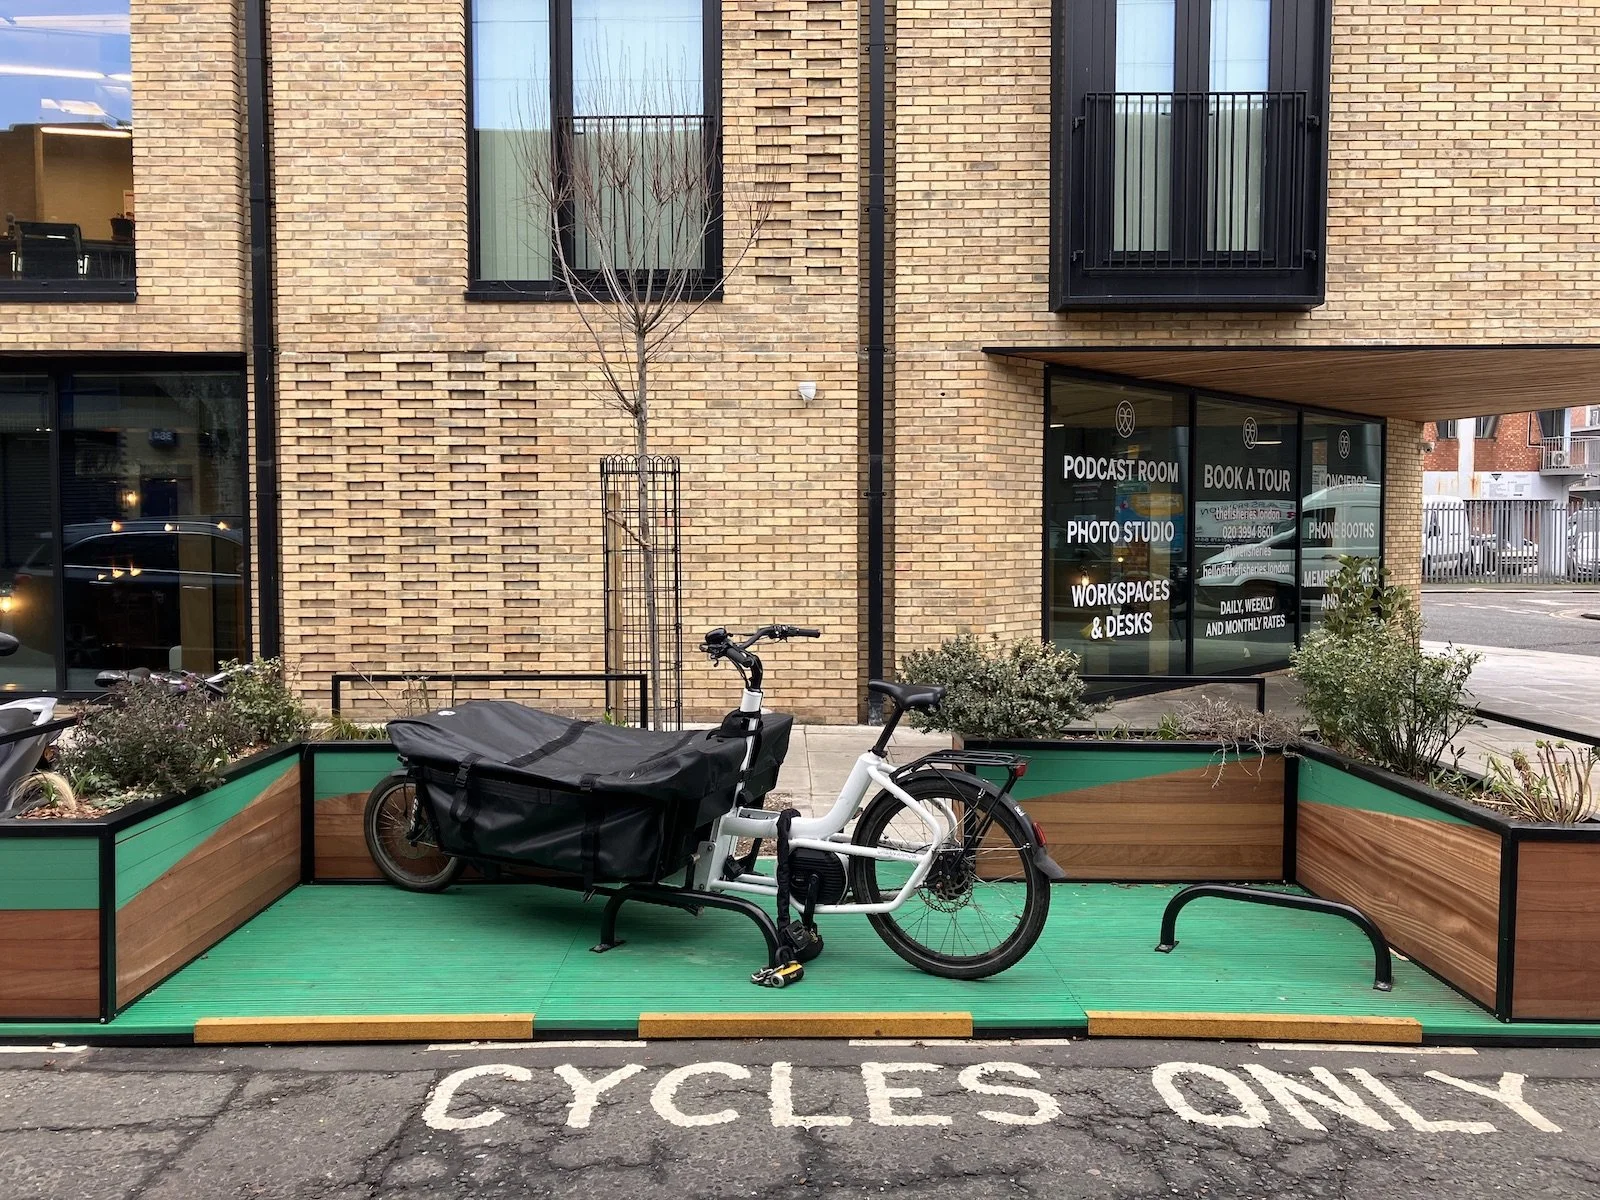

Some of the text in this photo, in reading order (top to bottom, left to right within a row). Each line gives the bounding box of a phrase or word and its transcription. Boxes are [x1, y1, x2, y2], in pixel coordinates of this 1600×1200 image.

[1063, 455, 1179, 483] PODCAST ROOM
[1204, 464, 1291, 492] BOOK A TOUR
[1215, 507, 1280, 520] thefisheries.london
[1067, 521, 1175, 543] PHOTO STUDIO
[1222, 526, 1274, 539] 020 3994 8601
[1309, 521, 1375, 539] PHONE BOOTHS
[1202, 562, 1290, 578] hello@thefisheries.london
[1071, 580, 1170, 607] WORKSPACES
[1220, 596, 1274, 615] DAILY, WEEKLY
[1091, 612, 1153, 639] & DESKS
[1205, 614, 1286, 637] AND MONTHLY RATES
[421, 1061, 1563, 1134] CYCLES ONLY
